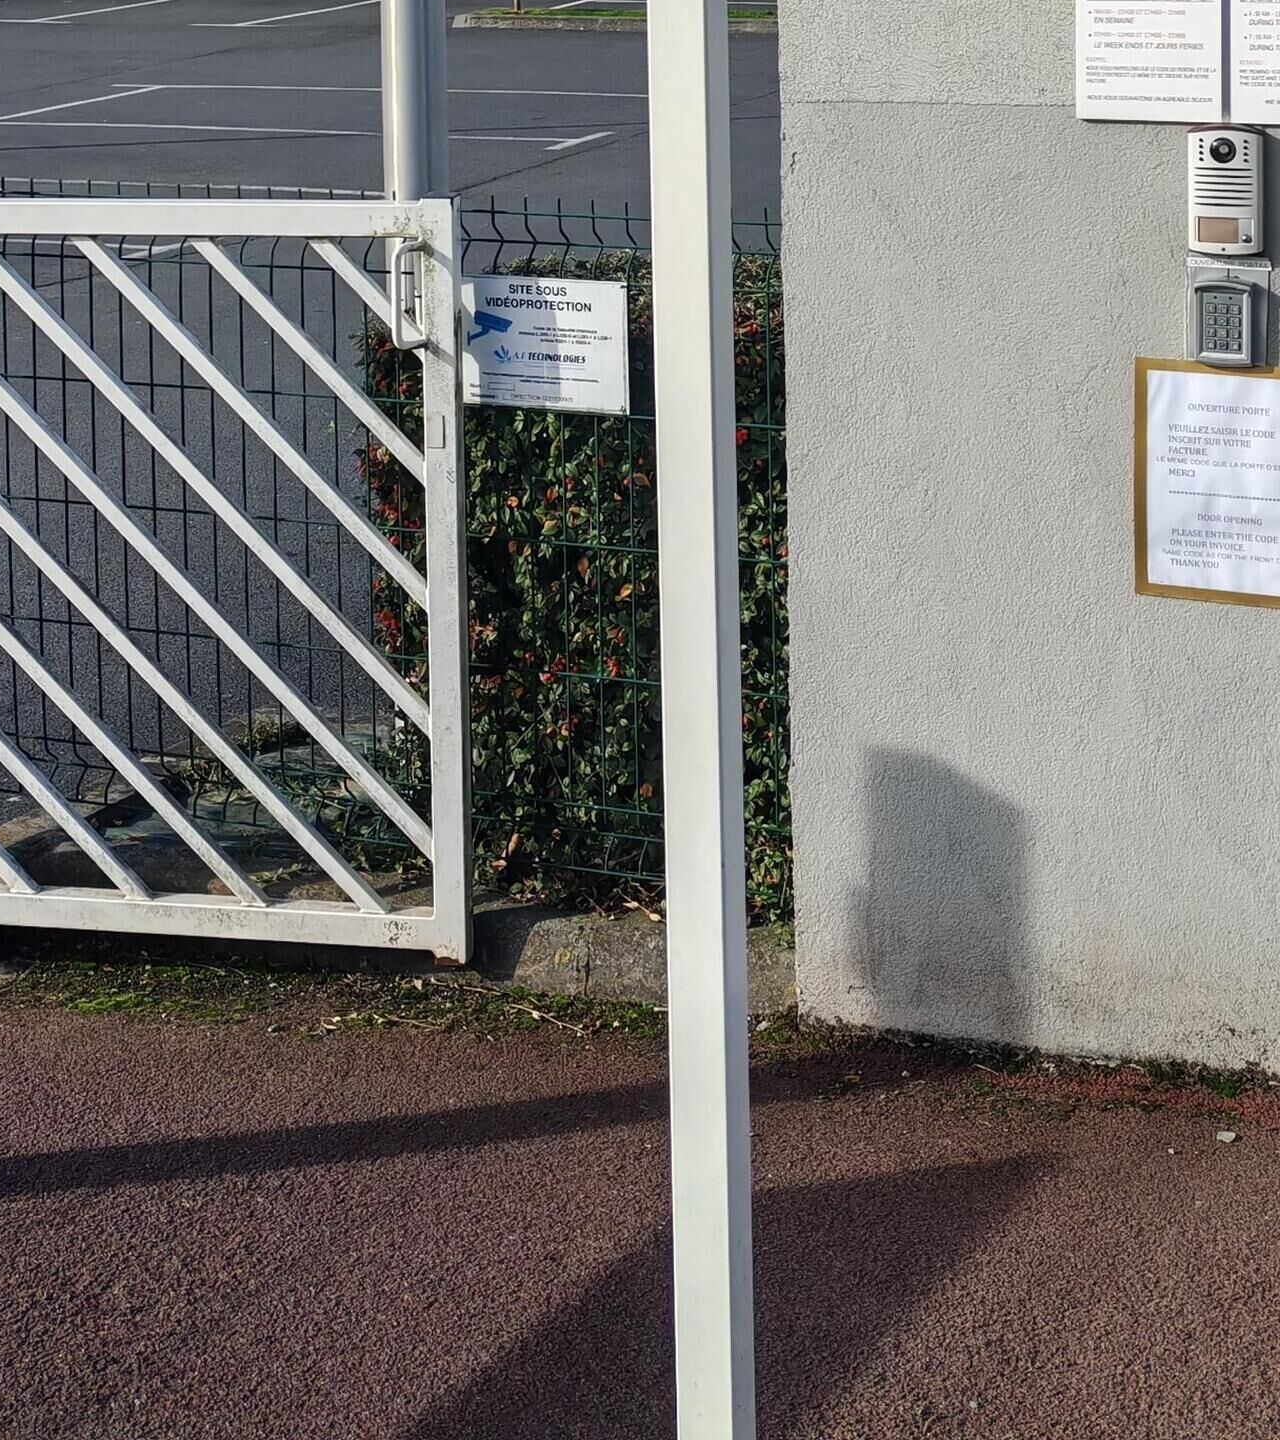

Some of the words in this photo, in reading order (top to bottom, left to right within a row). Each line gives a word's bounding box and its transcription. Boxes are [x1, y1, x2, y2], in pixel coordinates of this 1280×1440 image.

[1248, 44, 1274, 52] DURING
[509, 284, 533, 295] SITE
[536, 285, 567, 296] SOUS
[485, 296, 592, 312] VIDÉOPROTECTION
[528, 352, 586, 364] TECHNOLOGIES
[1188, 402, 1240, 414] OUVERTURE
[1242, 406, 1271, 417] PORTE
[1168, 423, 1209, 435] VEUILLEZ
[1210, 427, 1238, 436] SAISIR
[1240, 428, 1251, 437] LE
[1252, 430, 1276, 440] CODE
[1168, 435, 1201, 445] INSCRIT
[1204, 437, 1221, 446] SUR
[1223, 439, 1252, 448] VOTRE
[1190, 458, 1210, 466] CODE
[1212, 460, 1228, 468] QUE
[1229, 460, 1239, 468] LA
[1240, 462, 1264, 471] PORTE
[1168, 468, 1196, 478] MERCI
[1197, 513, 1222, 523] DOOR
[1223, 515, 1263, 526] OPENING
[1171, 528, 1204, 538] PLEASE
[1205, 530, 1234, 540] ENTER
[1235, 533, 1253, 542] THE
[1254, 534, 1279, 544] CODE
[1169, 538, 1183, 546] ON
[1184, 540, 1208, 549] YOUR
[1209, 541, 1245, 552] INVOICE.
[1170, 558, 1200, 568] THANK
[1202, 560, 1220, 569] YOU
[1183, 550, 1203, 558] CODE
[1250, 555, 1274, 564] FRONT
